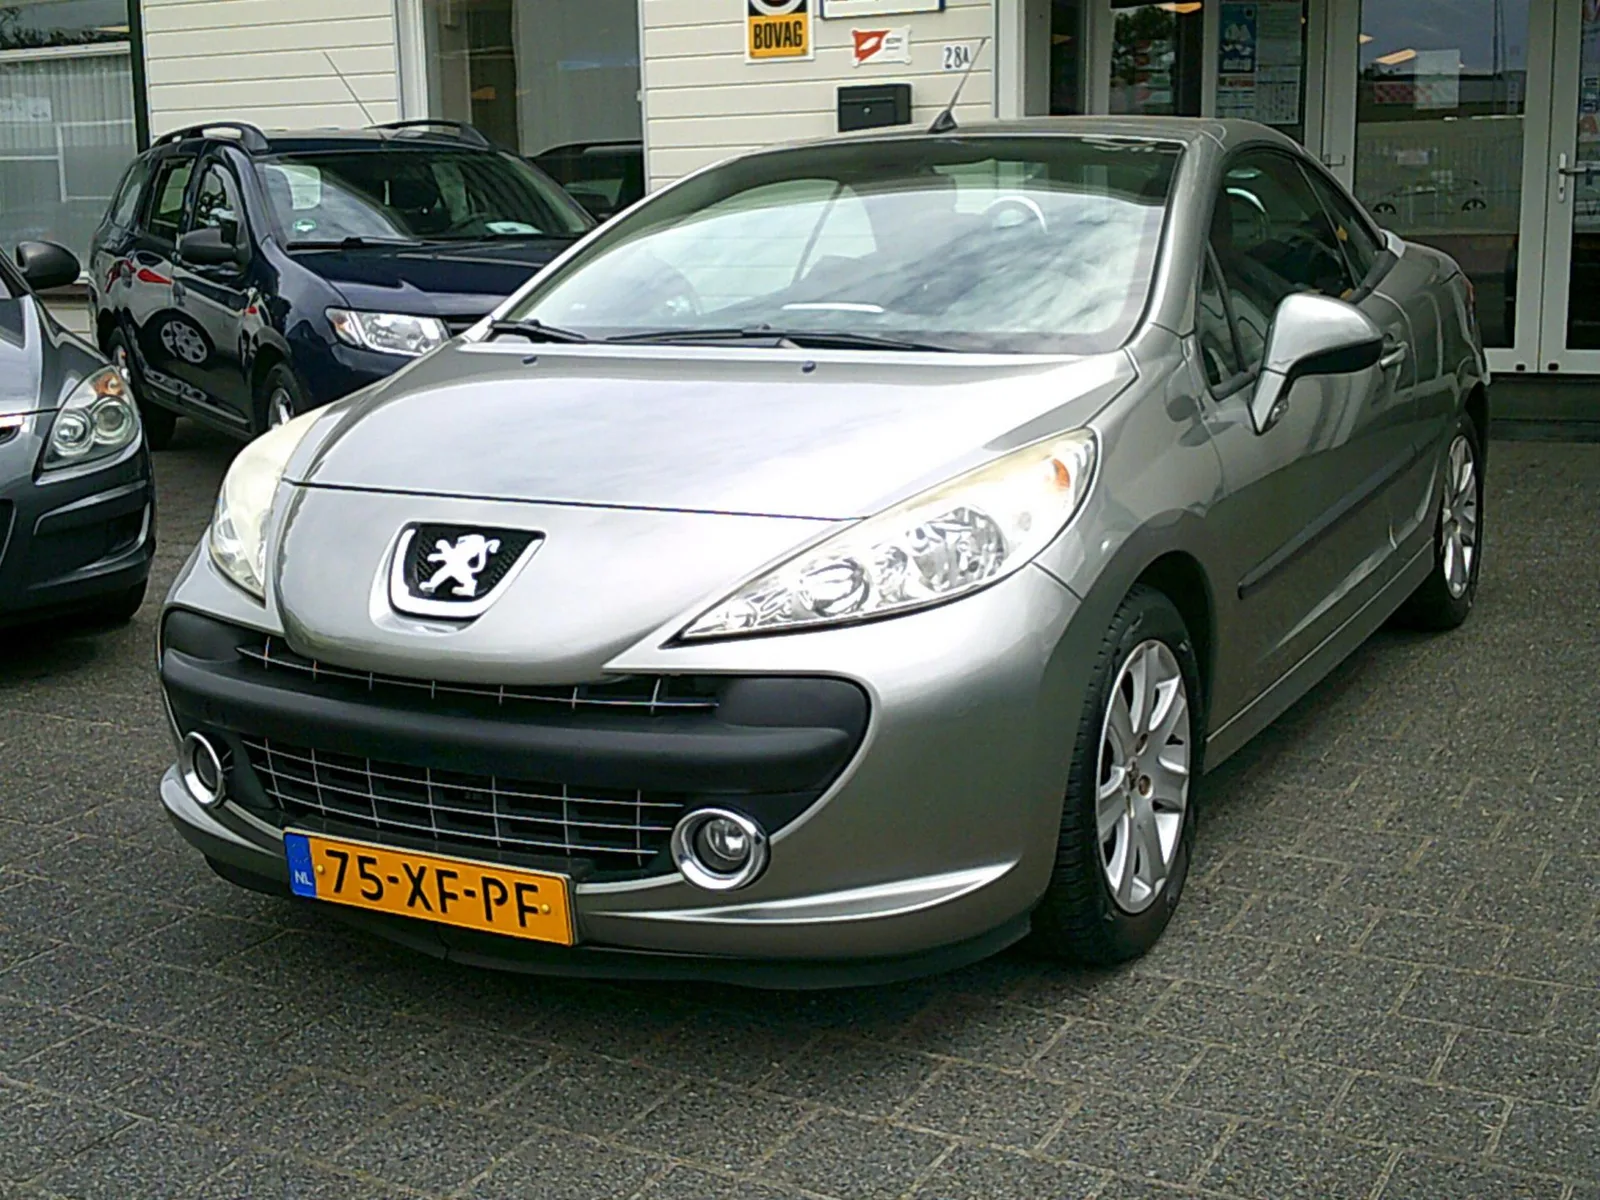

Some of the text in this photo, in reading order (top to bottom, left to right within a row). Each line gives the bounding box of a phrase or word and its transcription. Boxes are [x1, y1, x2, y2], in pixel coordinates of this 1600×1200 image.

[753, 20, 803, 50] BOVAG
[294, 869, 313, 887] NL
[325, 849, 539, 928] 75-XF-PF
